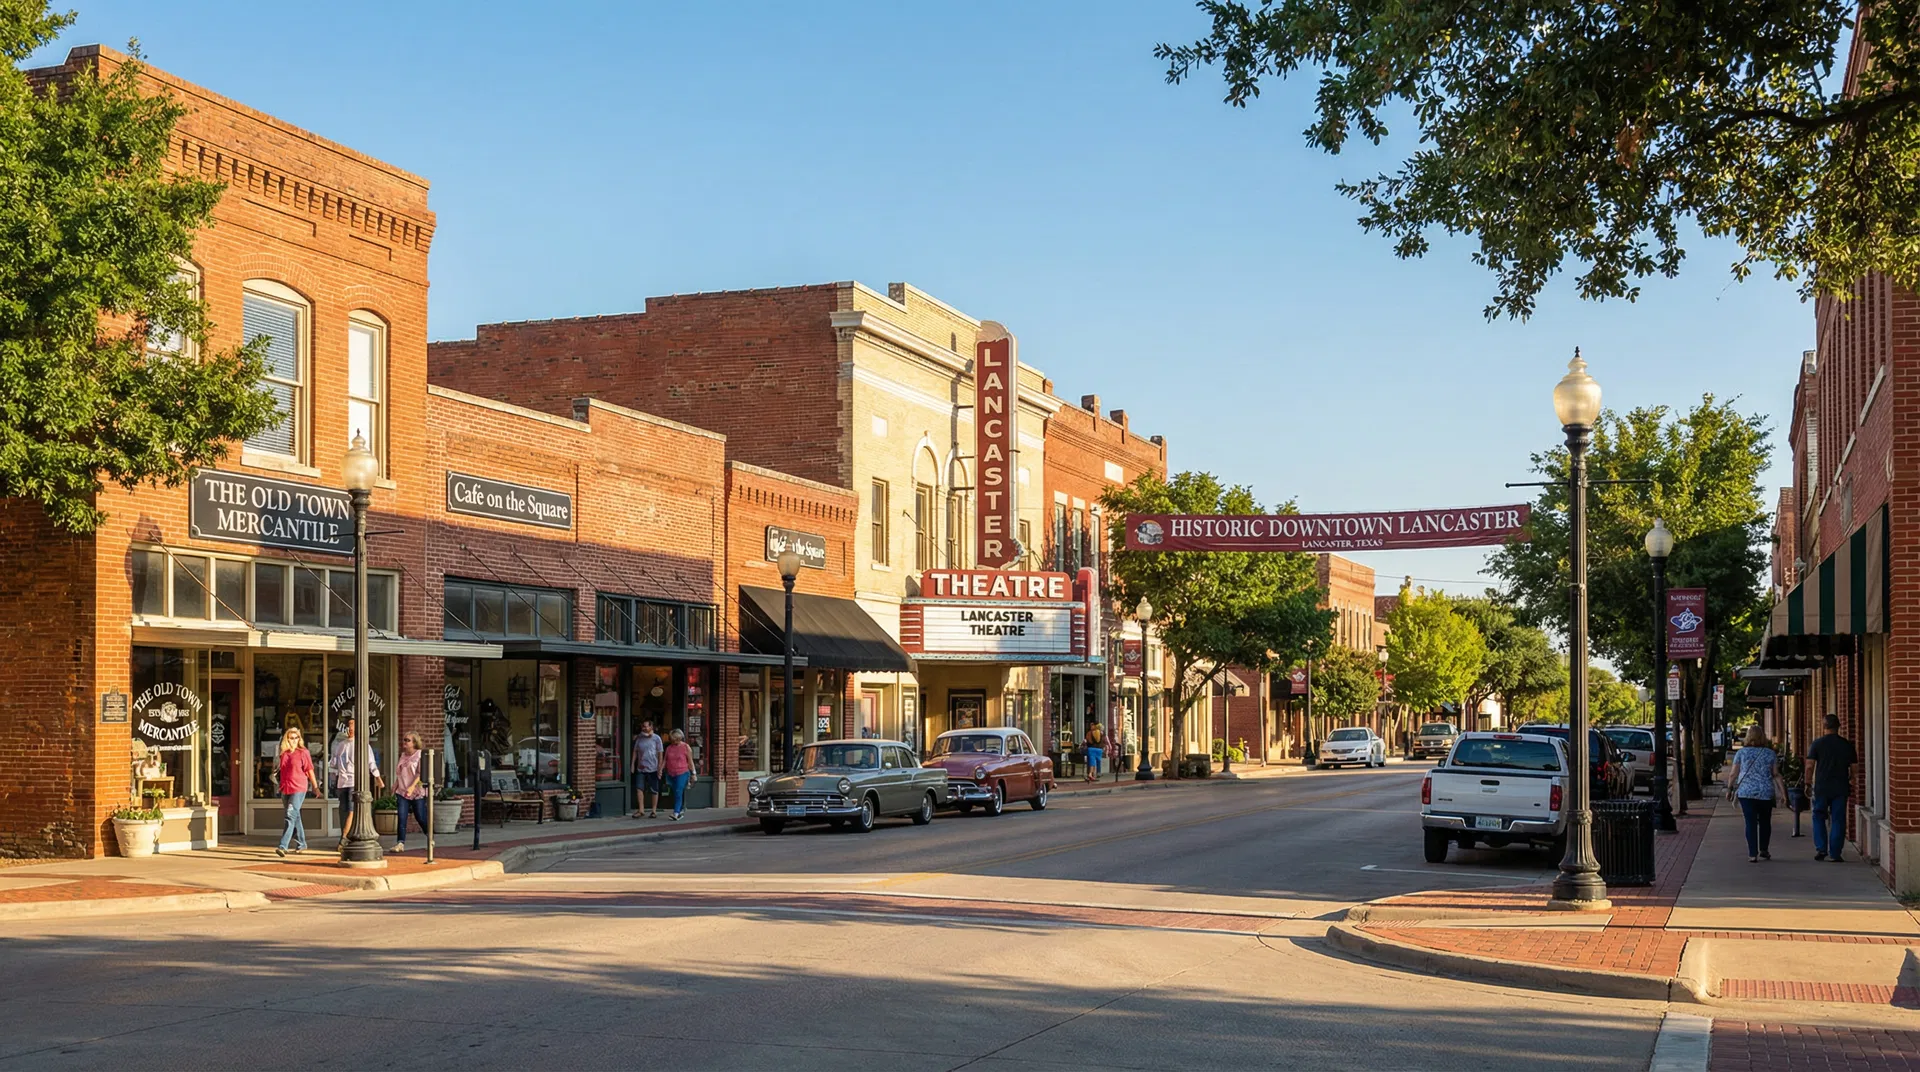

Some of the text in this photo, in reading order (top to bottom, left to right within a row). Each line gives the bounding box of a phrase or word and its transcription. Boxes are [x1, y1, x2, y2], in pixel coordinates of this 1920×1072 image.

[983, 348, 1004, 558] LANCASTER
[204, 478, 350, 521] THE OLD TOWN
[454, 481, 569, 520] Café on the Square
[217, 507, 340, 545] MERCANTILE
[1170, 509, 1522, 538] HISTORIC DOWNTOWN LANCASTER
[1302, 538, 1383, 549] LANCASTER, TEXAS
[930, 573, 1065, 599] THEATRE
[960, 610, 1034, 623] LANCASTER
[969, 624, 1026, 637] THEATRE
[133, 688, 154, 713] THE
[153, 682, 174, 698] OLD
[176, 684, 204, 712] TOWN
[331, 691, 347, 712] THE
[368, 689, 386, 711] OWN
[138, 718, 200, 741] MERCANTILE
